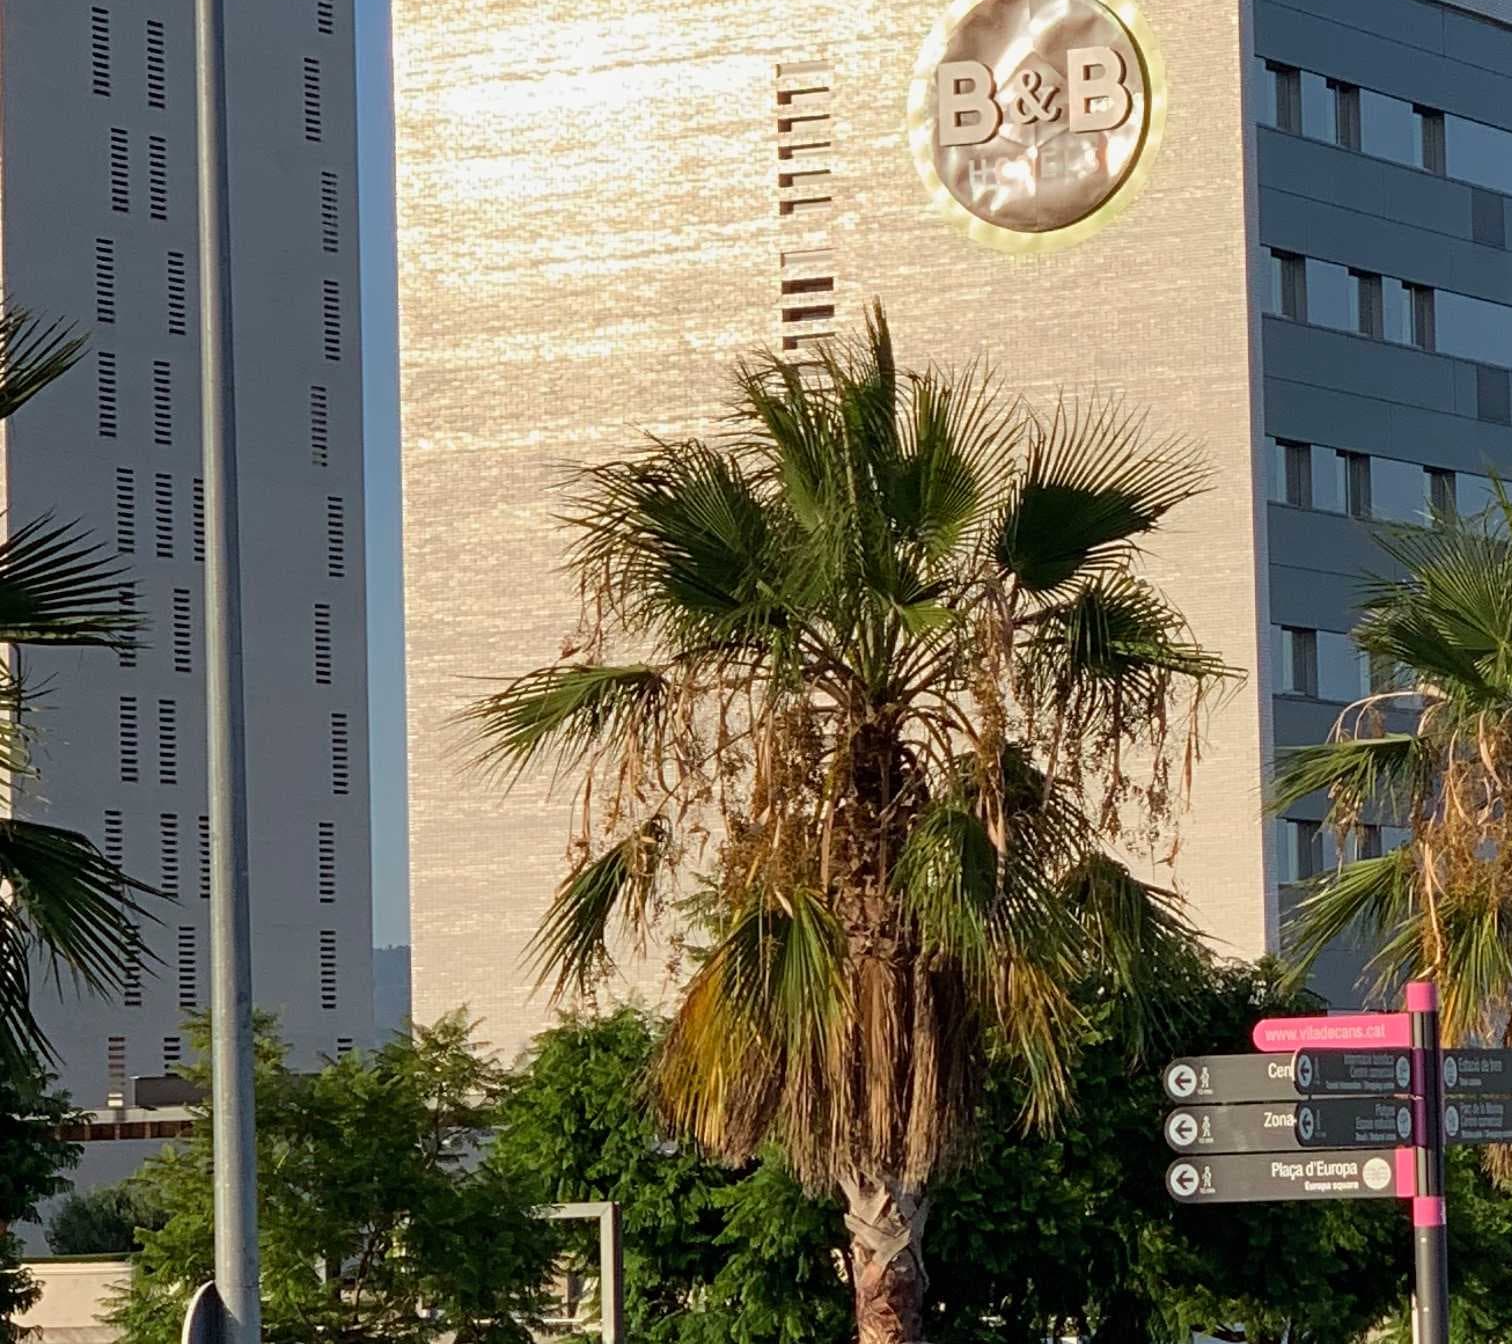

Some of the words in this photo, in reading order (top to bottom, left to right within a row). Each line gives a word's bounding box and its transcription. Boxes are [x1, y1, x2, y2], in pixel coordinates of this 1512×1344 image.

[937, 45, 1133, 147] B&B
[1264, 1024, 1385, 1041] www.viladecans.cat
[1271, 1161, 1303, 1181] Plaça
[1305, 1160, 1358, 1178] d'Europa
